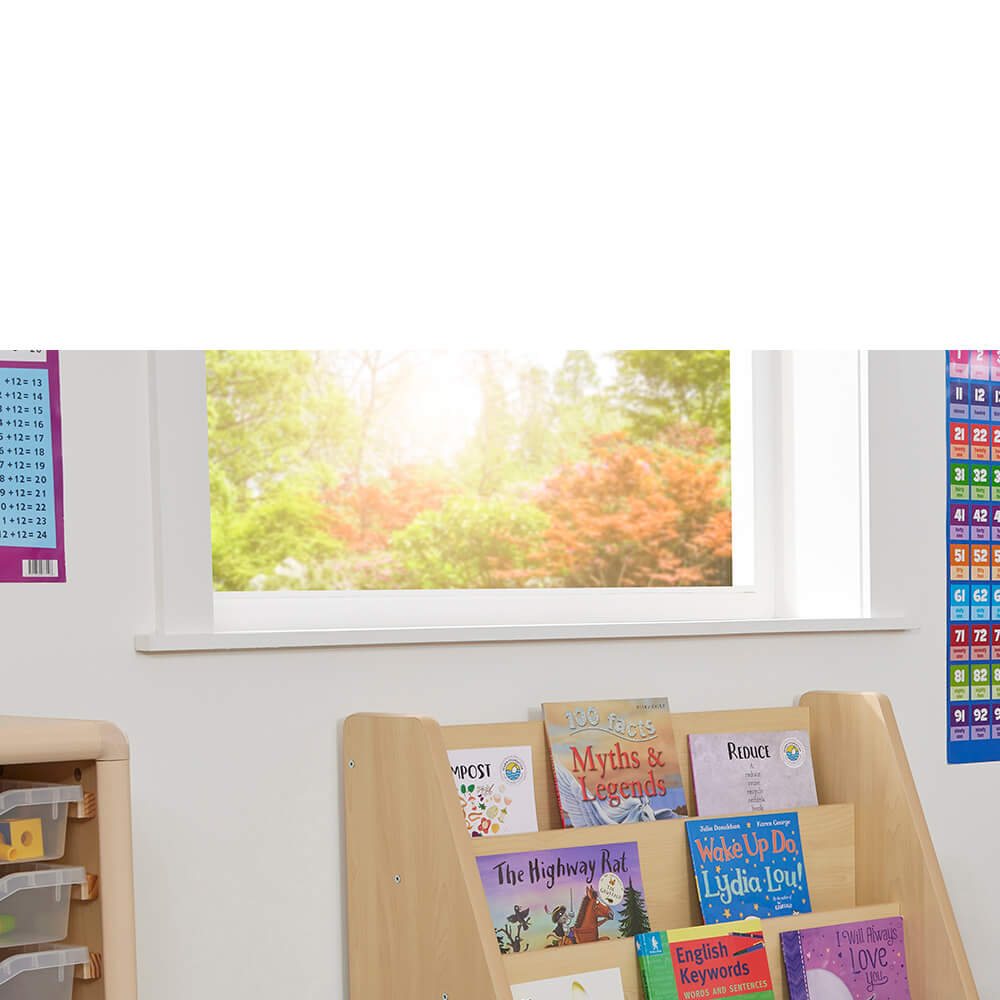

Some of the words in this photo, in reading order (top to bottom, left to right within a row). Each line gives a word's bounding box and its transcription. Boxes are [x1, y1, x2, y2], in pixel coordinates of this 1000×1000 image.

[956, 387, 962, 400] 11
[975, 389, 985, 401] 12
[35, 462, 45, 470] 19
[955, 468, 964, 481] 31
[974, 469, 987, 482] 32
[35, 475, 47, 484] 20
[35, 489, 46, 498] 21
[955, 549, 964, 562] 51
[974, 549, 987, 562] 52
[565, 706, 599, 729] 100
[608, 712, 656, 738] facts
[955, 710, 964, 722] 91
[974, 709, 987, 721] 92
[569, 742, 640, 778] Myths
[647, 746, 665, 768] &
[727, 741, 771, 760] REDUCE
[578, 770, 667, 807] Legends
[695, 836, 743, 863] Wake
[742, 832, 769, 862] Up
[771, 830, 799, 855] Do,
[493, 861, 525, 886] The
[529, 858, 596, 889] Highway
[601, 849, 629, 873] Rat
[702, 868, 762, 904] Lydia
[764, 862, 802, 892] Lou!
[836, 931, 840, 947] I
[842, 928, 865, 945] Will
[866, 926, 898, 946] Always
[676, 942, 728, 965] English
[680, 961, 750, 986] Keywords
[684, 988, 710, 999] WORDS
[712, 986, 726, 995] AND
[729, 980, 768, 993] SENTENCES
